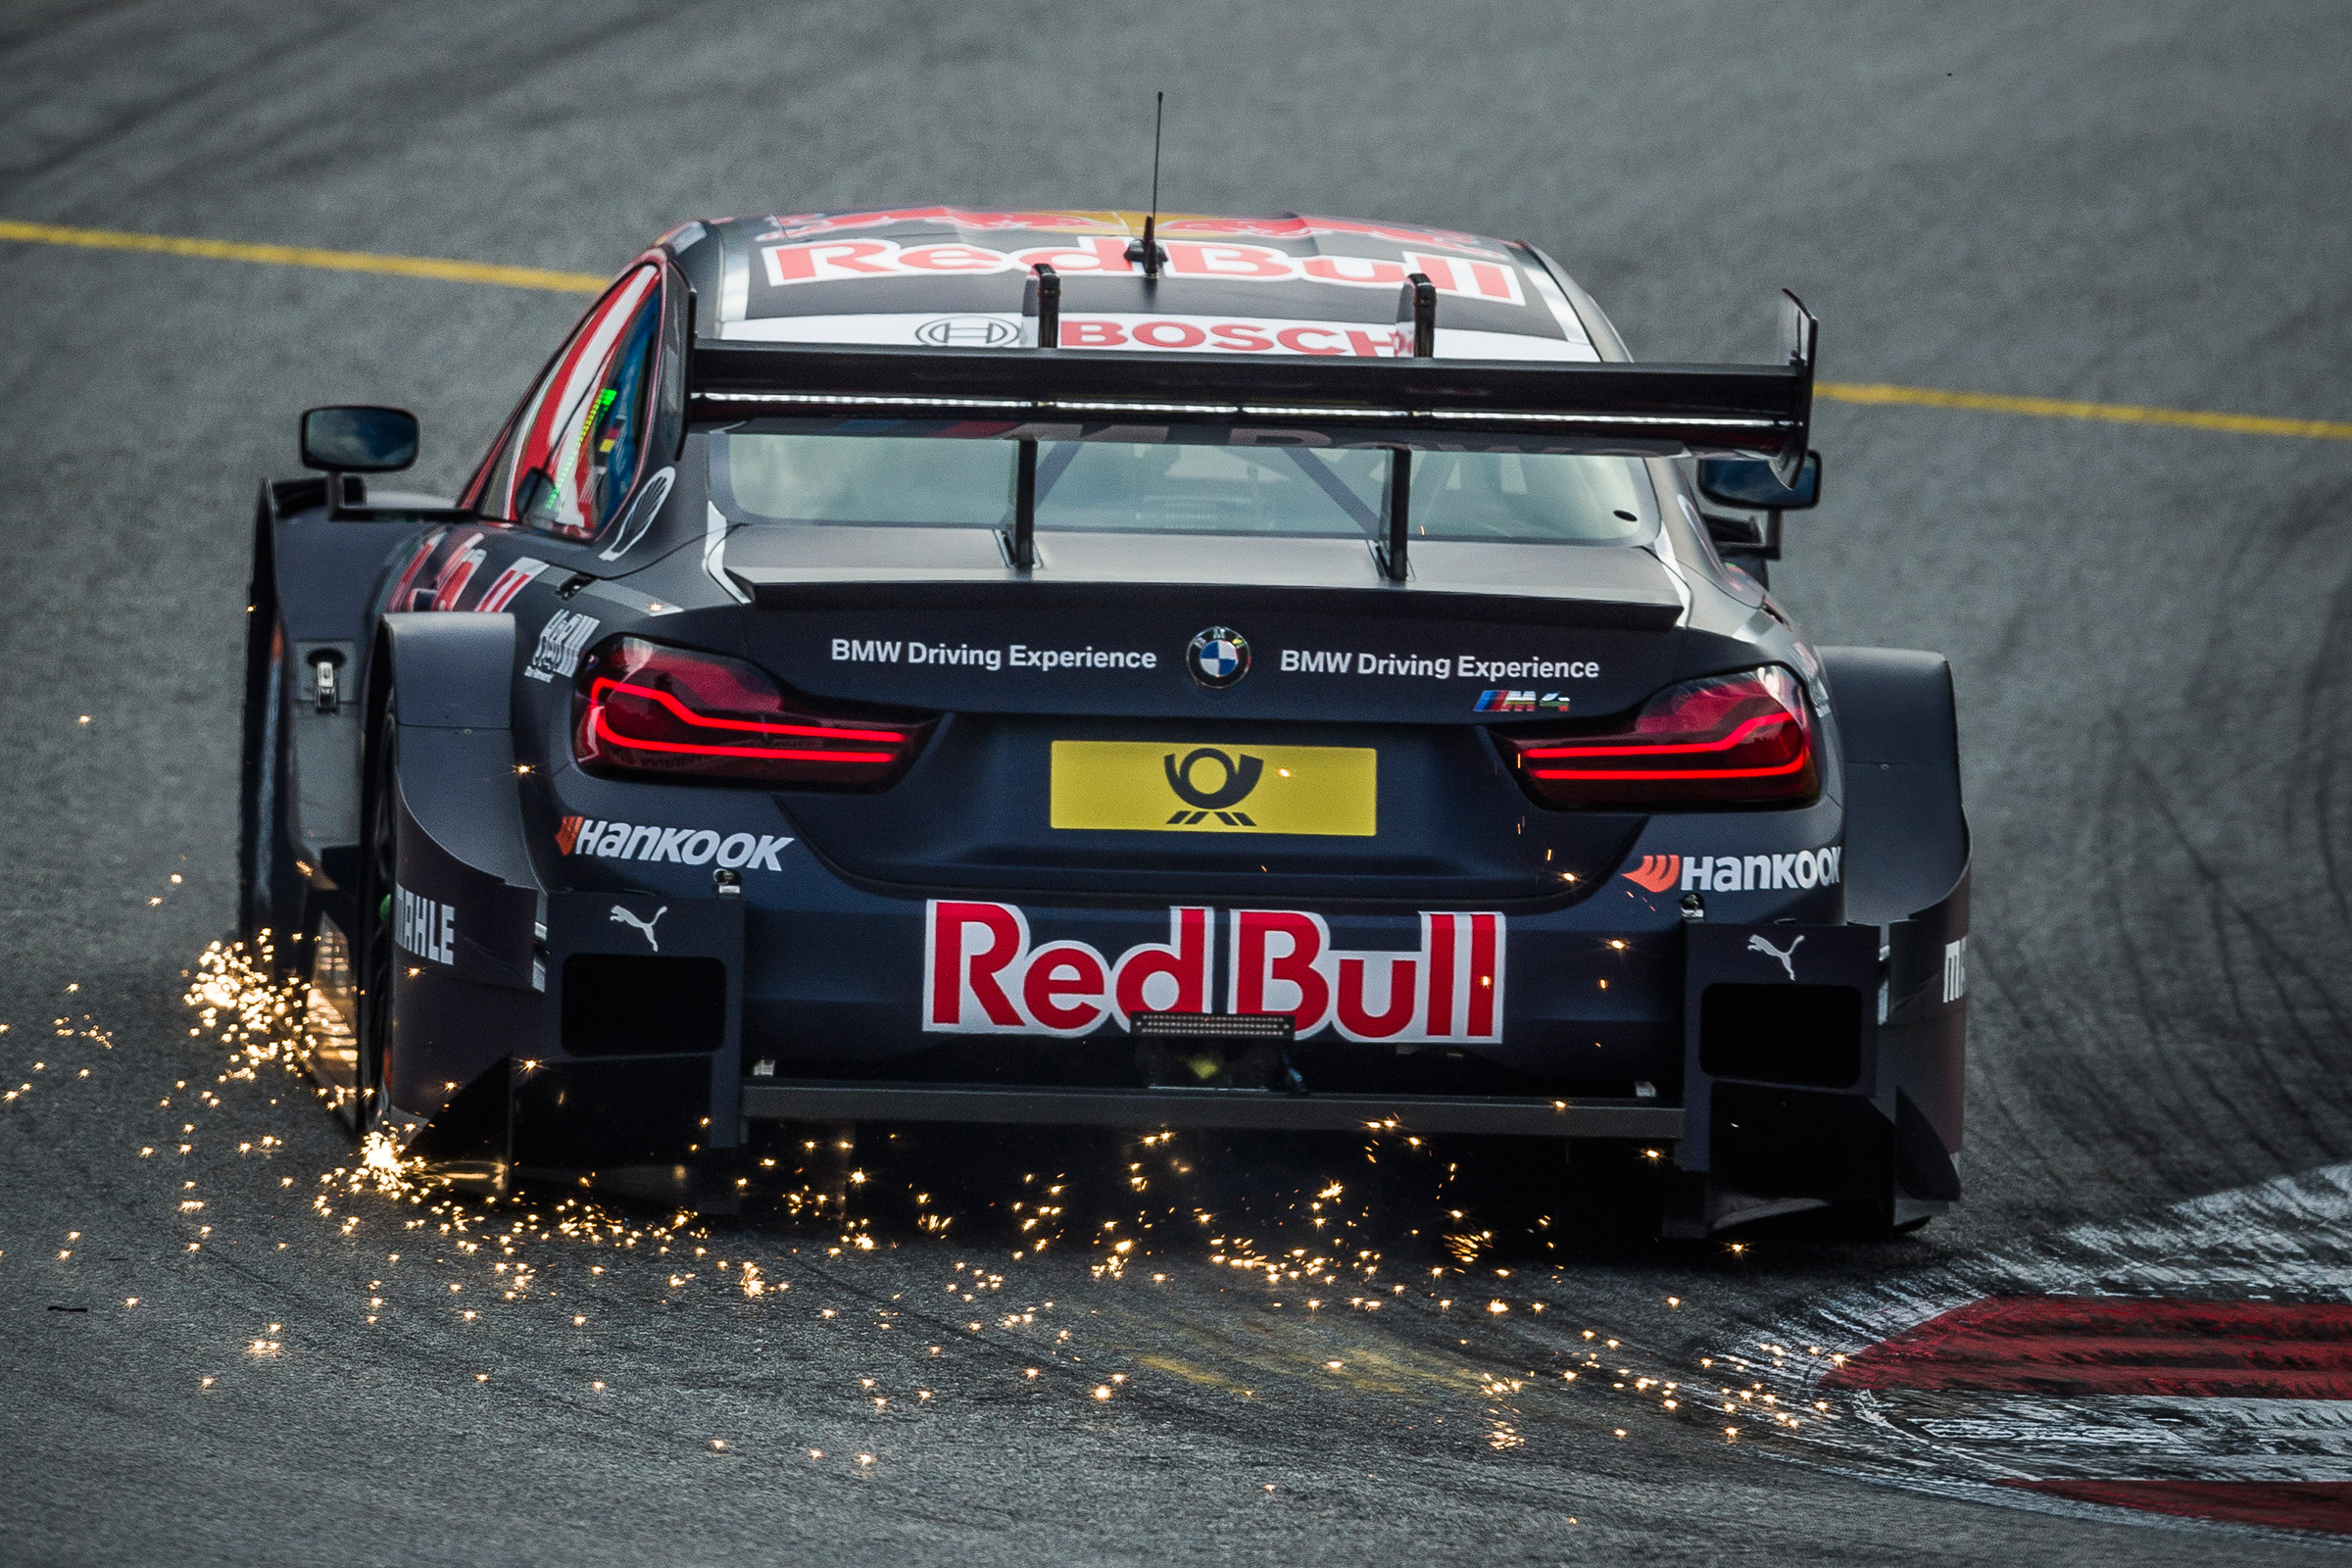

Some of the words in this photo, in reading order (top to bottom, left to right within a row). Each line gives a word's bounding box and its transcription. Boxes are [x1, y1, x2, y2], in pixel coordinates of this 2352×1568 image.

[762, 235, 1137, 287] Red
[1163, 238, 1525, 306] Bull
[831, 638, 902, 663] BMW
[907, 642, 1002, 671] Driving
[1008, 644, 1157, 672] Experience
[1279, 649, 1351, 674] BMW
[1357, 653, 1450, 680] Driving
[1456, 655, 1599, 683] Experience
[923, 899, 1214, 1038] Red
[1226, 908, 1507, 1045] Bull
